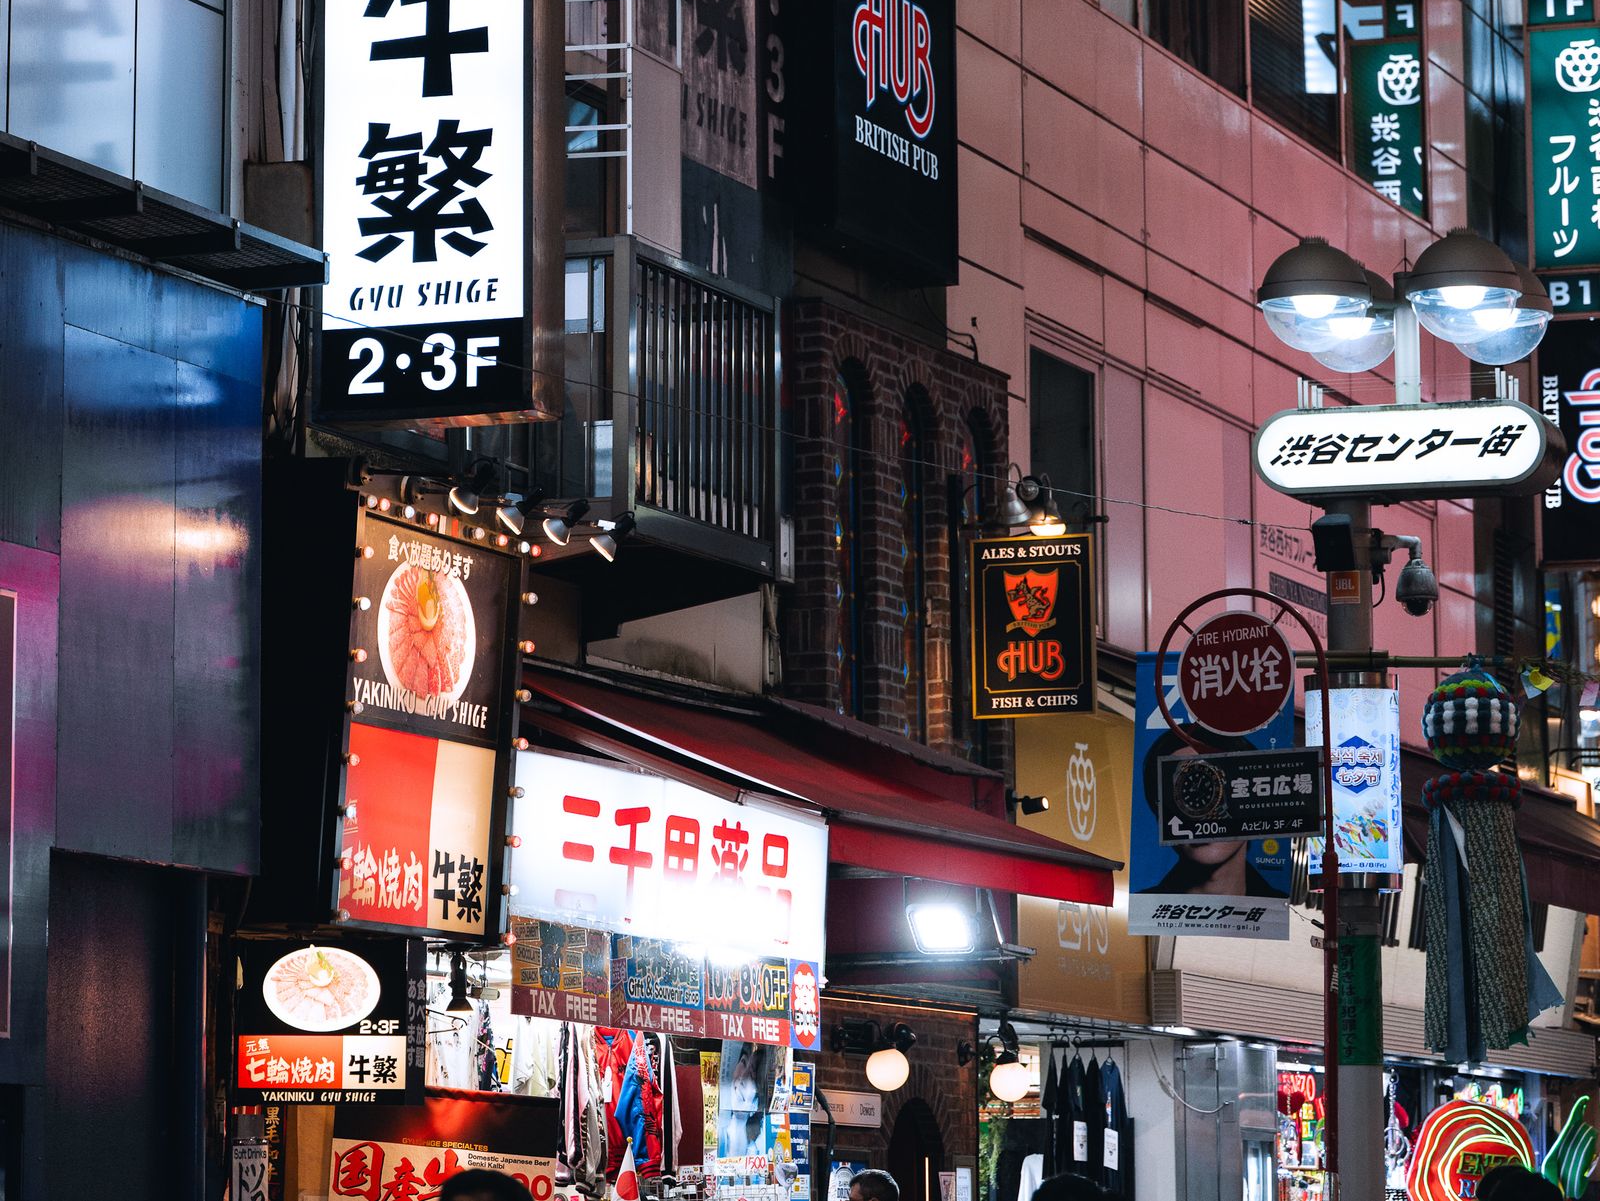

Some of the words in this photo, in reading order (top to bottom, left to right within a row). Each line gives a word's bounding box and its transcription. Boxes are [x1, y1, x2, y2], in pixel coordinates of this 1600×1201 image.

[854, 113, 910, 170] BRITISH
[912, 146, 939, 182] PUB
[1548, 134, 1580, 258] フルーツ
[417, 277, 500, 308] SHIGE
[1269, 423, 1528, 467] 渋谷センター街
[387, 533, 474, 582] 食べ放題あります
[981, 547, 1015, 561] ALES
[1016, 547, 1028, 559] &
[1028, 543, 1082, 558] STOUTS
[1196, 632, 1220, 647] FIRE
[1222, 625, 1271, 644] HYDRANT
[996, 639, 1066, 682] HUB
[1189, 645, 1284, 701] 消火栓
[353, 676, 417, 715] YAKINIKU
[451, 700, 489, 730] SHIGE
[991, 696, 1023, 709] FISH
[1025, 696, 1036, 708] &
[1036, 694, 1079, 707] CHIPS
[1230, 773, 1313, 799] 宝石広場
[1194, 821, 1227, 836] 200m
[1241, 819, 1271, 832] A2ビル
[1255, 856, 1287, 867] SUNCUT
[432, 848, 485, 925] 牛繁
[1151, 903, 1267, 923] 渋谷センター街
[628, 976, 645, 999] Gift
[654, 982, 683, 1004] Souvenir
[529, 988, 557, 1016] TAX
[566, 993, 598, 1023] FREE
[626, 1003, 653, 1029] TAX
[660, 1007, 691, 1032] FREE
[406, 978, 417, 1068] あります
[414, 978, 427, 1068] 食べ放題
[720, 1013, 745, 1039] TAX
[751, 1016, 781, 1042] FREE
[245, 1037, 271, 1054] 元氣
[245, 1055, 335, 1085] 七輪焼肉
[348, 1054, 398, 1085] 牛繁
[261, 1091, 315, 1103] YAKINIKU
[320, 1091, 342, 1103] GYU
[344, 1091, 377, 1103] SHIGE
[233, 1148, 247, 1160] Soft
[247, 1148, 267, 1160] Drinks
[467, 1152, 500, 1163] Domestic
[500, 1156, 534, 1167] Japanese
[534, 1159, 550, 1168] Beef
[467, 1159, 487, 1168] Genki
[487, 1161, 506, 1170] Kalbi
